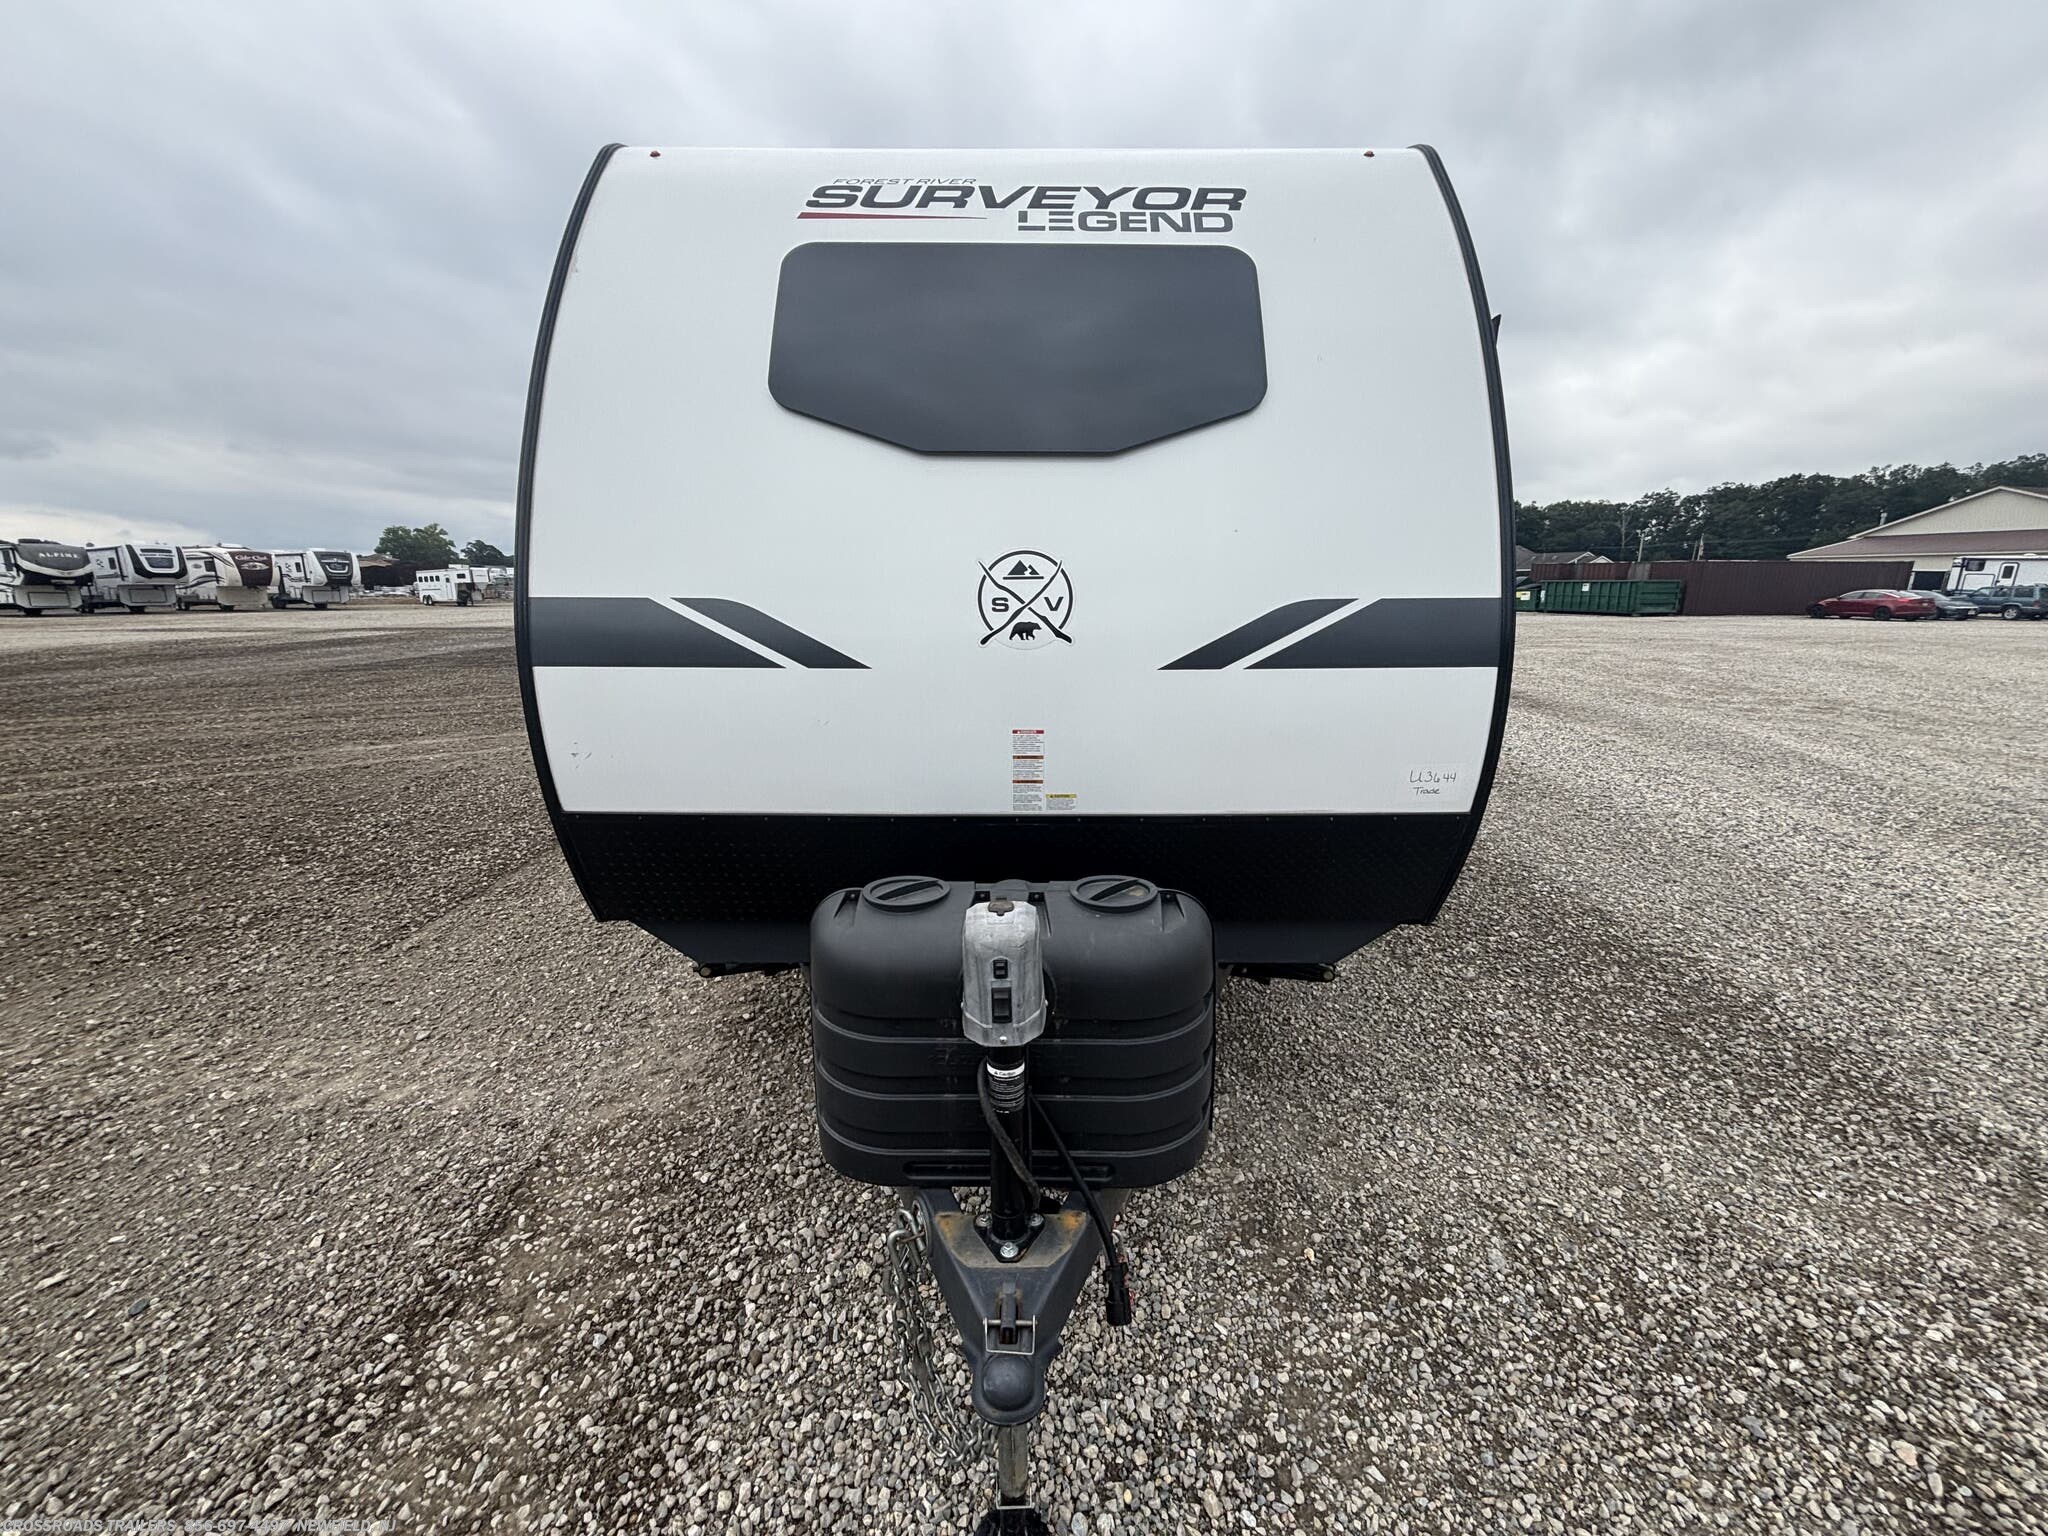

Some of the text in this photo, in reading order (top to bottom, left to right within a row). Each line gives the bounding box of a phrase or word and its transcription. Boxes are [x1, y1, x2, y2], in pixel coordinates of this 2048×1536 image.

[806, 185, 1247, 211] SURVEYOR
[1018, 210, 1234, 232] LEGEND
[991, 596, 1064, 613] S V
